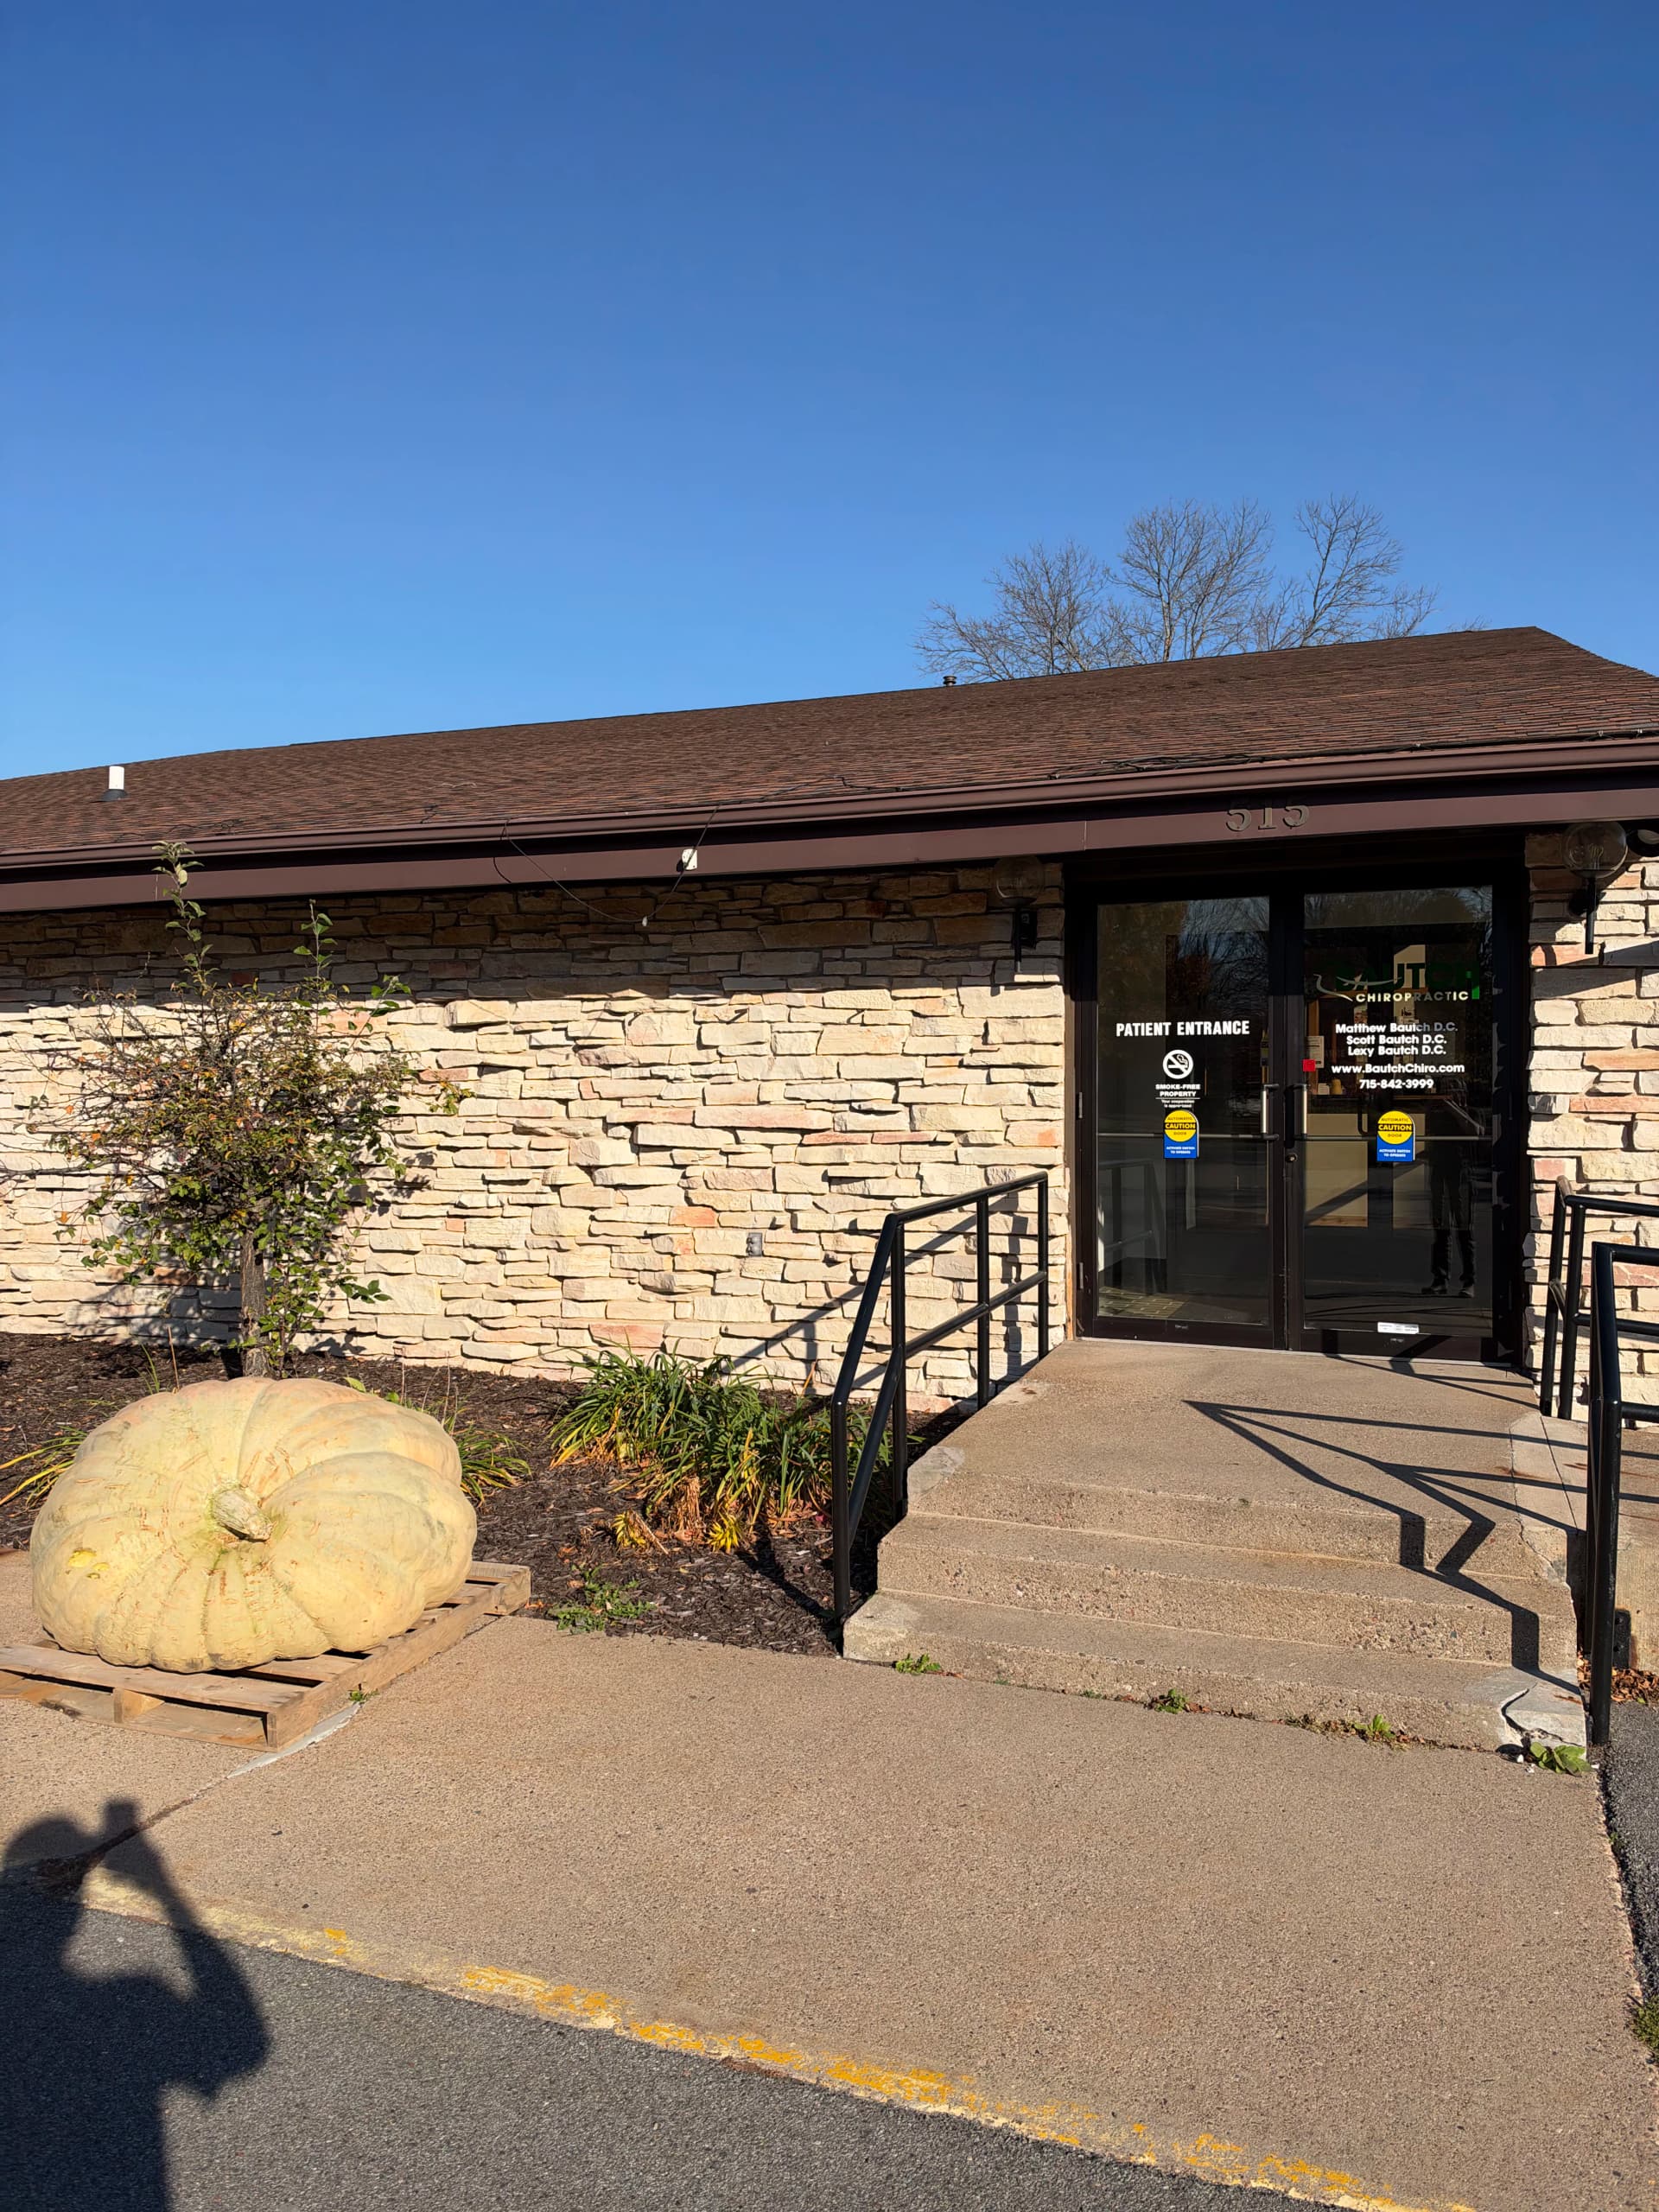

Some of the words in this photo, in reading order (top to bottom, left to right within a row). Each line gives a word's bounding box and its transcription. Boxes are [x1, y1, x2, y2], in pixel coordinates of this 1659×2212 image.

[1226, 796, 1310, 832] 515
[1356, 991, 1469, 1002] CHIROPRACTIC
[1116, 1021, 1172, 1037] PATIENT
[1177, 1020, 1250, 1035] ENTRANCE
[1335, 1024, 1386, 1033] Matthew
[1389, 1022, 1430, 1033] Bautch
[1433, 1022, 1459, 1032] D.C.
[1346, 1035, 1376, 1045] Scott
[1378, 1034, 1420, 1045] Bautch
[1422, 1034, 1447, 1044] D.C.
[1348, 1046, 1375, 1057] Lexy
[1377, 1046, 1419, 1055] Bautch
[1421, 1045, 1446, 1054] D.C.
[1331, 1064, 1465, 1073] www.BautchChiro.com
[1359, 1079, 1434, 1089] 715-842-3999
